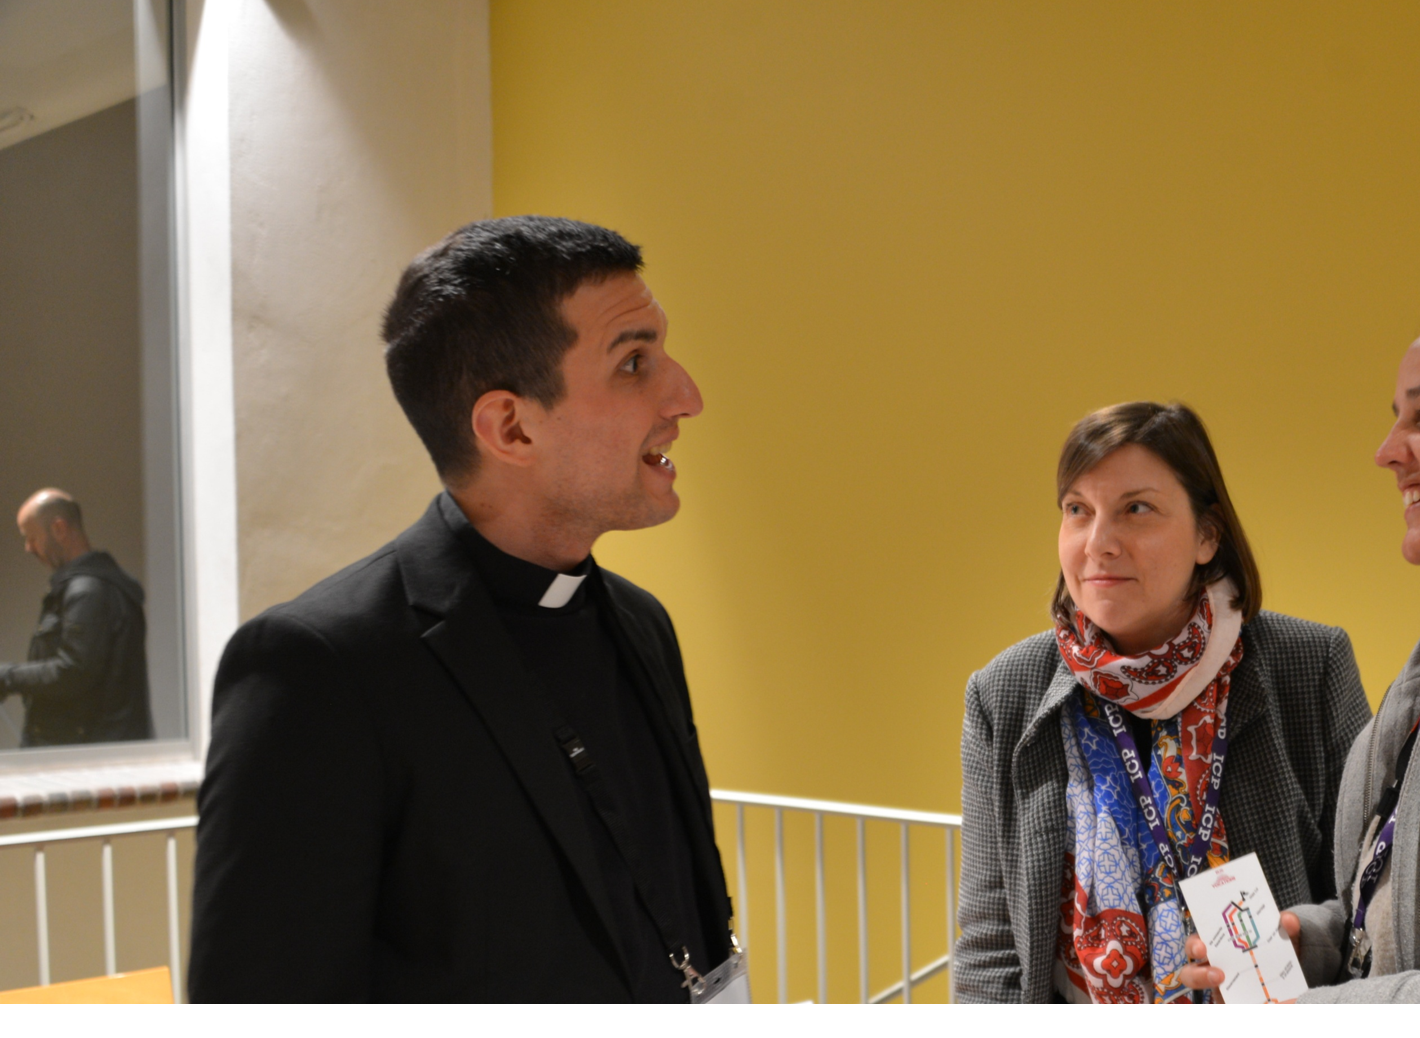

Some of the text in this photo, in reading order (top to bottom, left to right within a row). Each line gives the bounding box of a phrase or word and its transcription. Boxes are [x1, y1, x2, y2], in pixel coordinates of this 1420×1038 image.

[1104, 703, 1127, 738] ICP
[1121, 748, 1143, 784] ICP
[1211, 752, 1225, 790] ICP
[1139, 795, 1161, 831] ICP
[1198, 804, 1215, 842] ICP
[1188, 854, 1203, 877] IC
